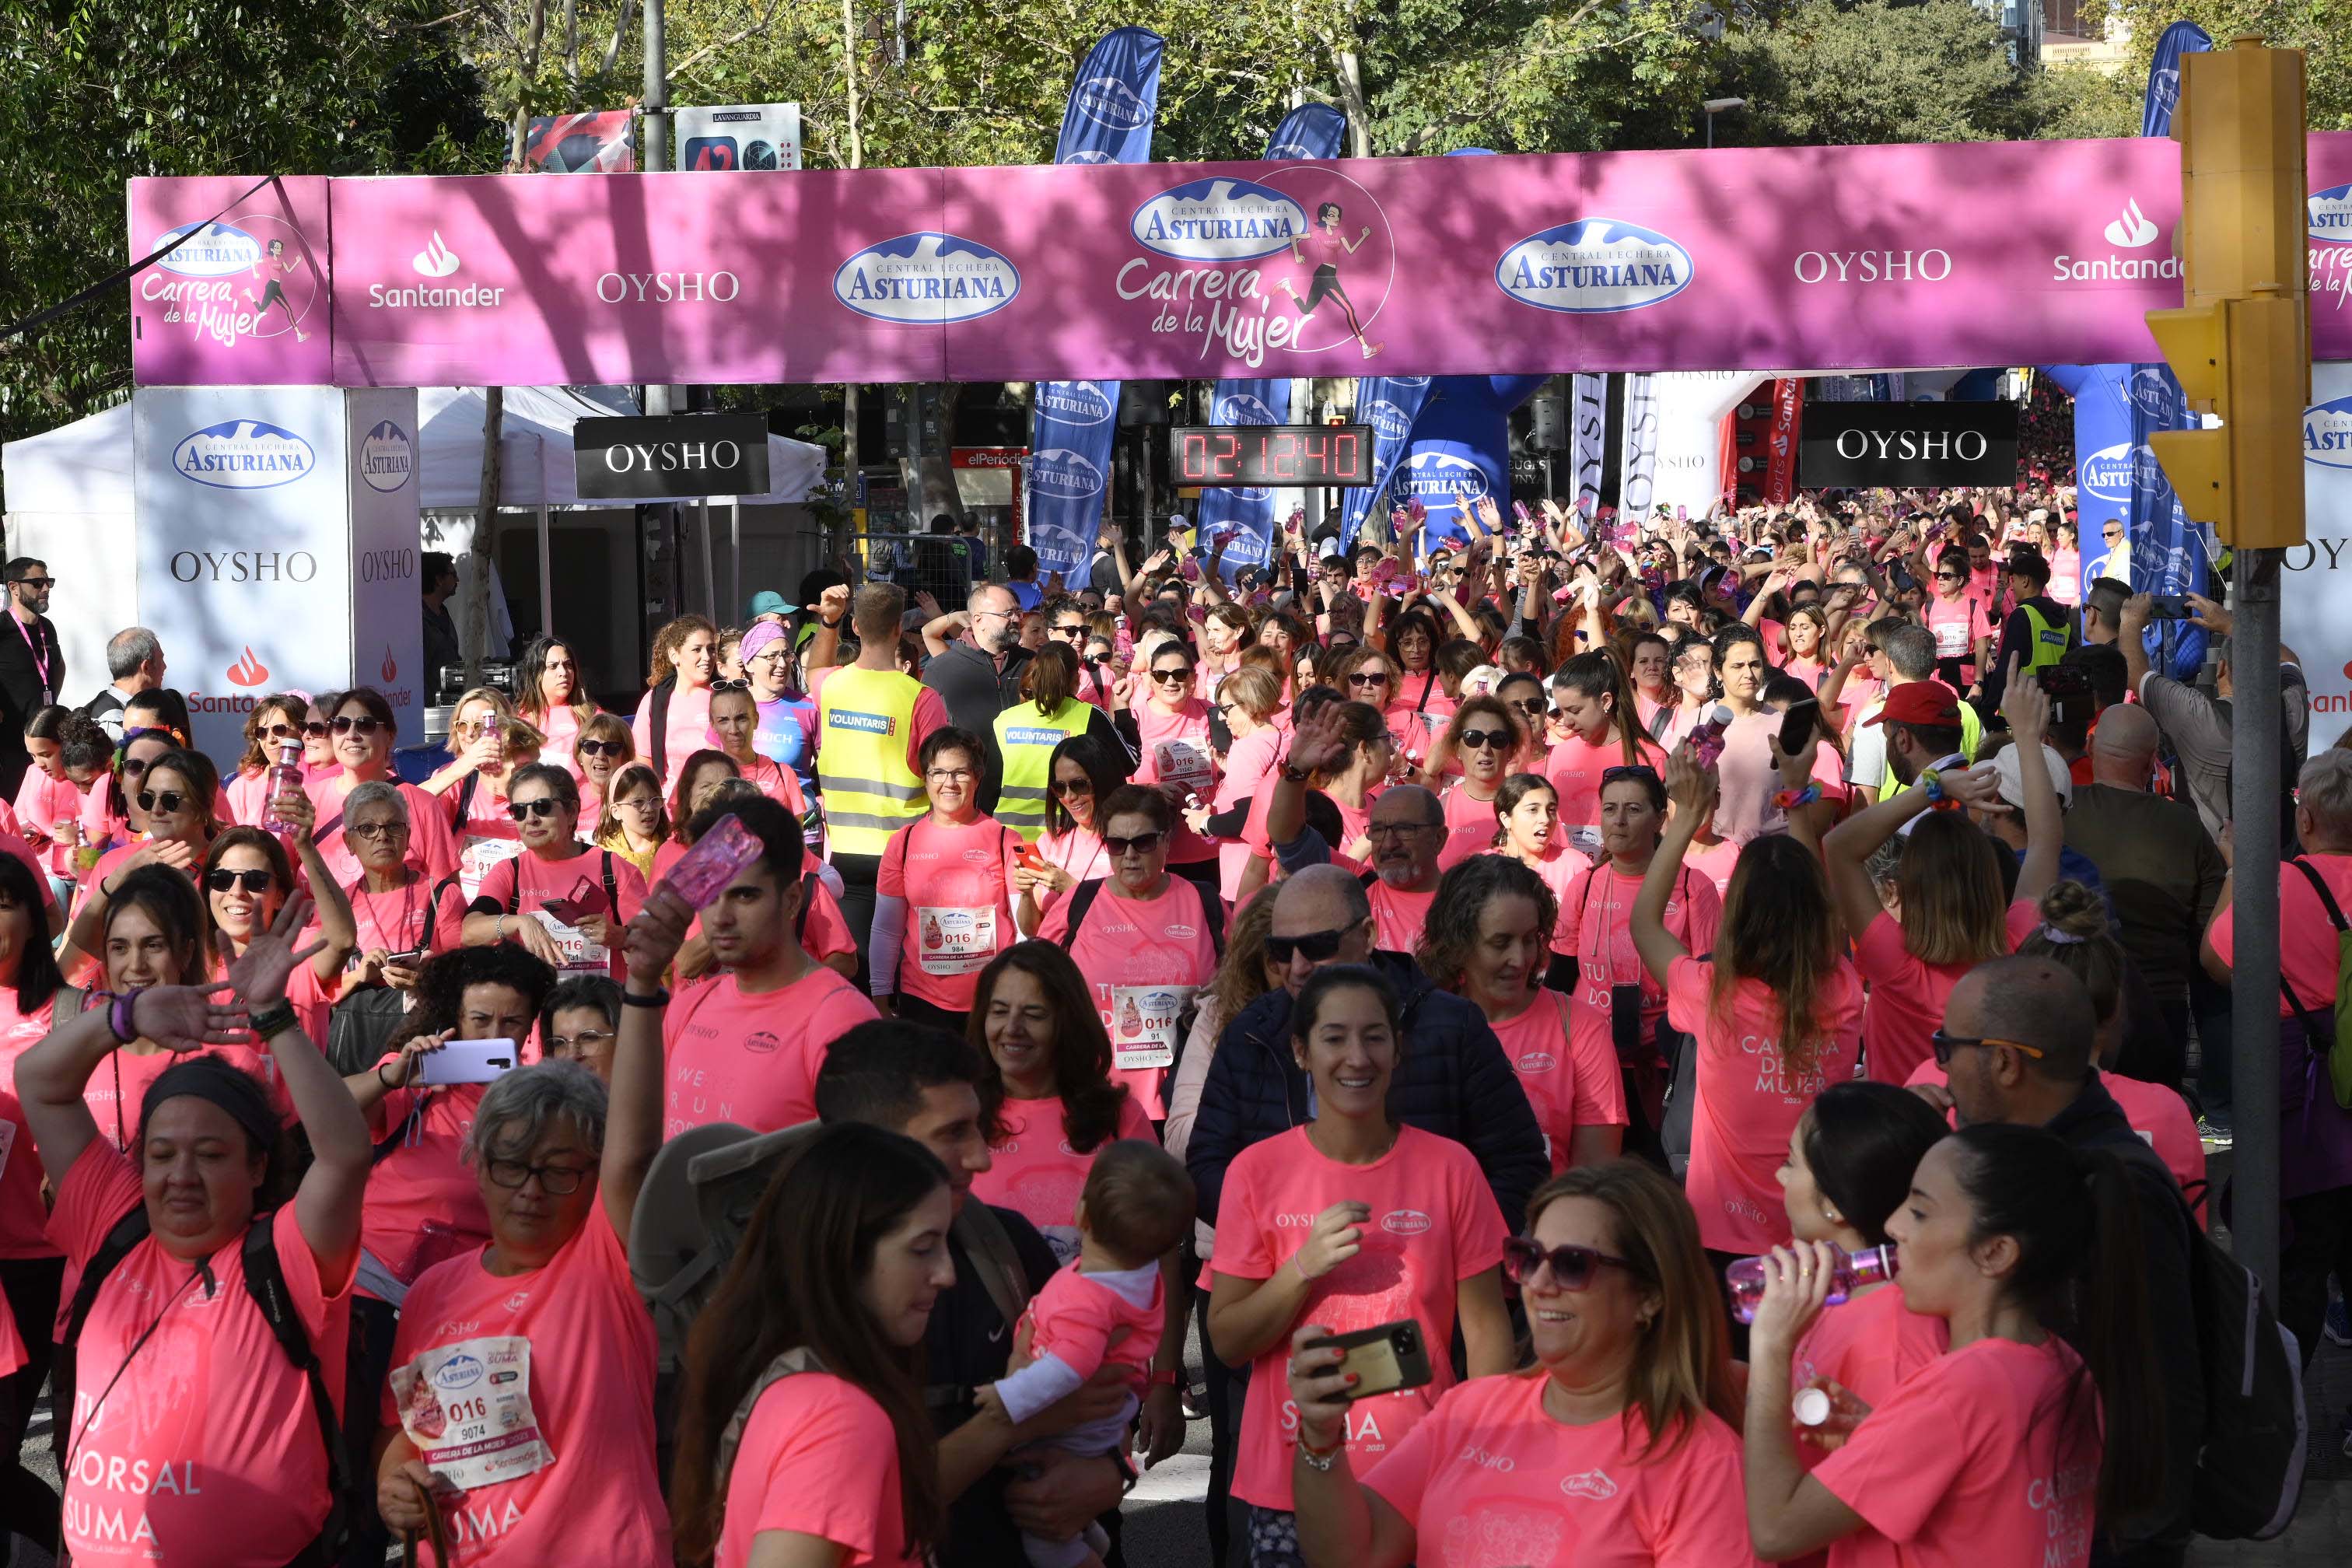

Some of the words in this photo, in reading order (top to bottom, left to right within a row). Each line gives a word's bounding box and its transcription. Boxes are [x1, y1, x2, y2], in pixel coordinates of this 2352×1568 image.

[1080, 86, 1140, 124] ASTURIANA
[1171, 206, 1226, 215] CENTRAL
[1232, 205, 1288, 215] LECHERA
[1144, 209, 1293, 240] ASTURIANA
[877, 264, 934, 273] CENTRAL
[941, 263, 999, 272] LECHERA
[1541, 251, 1602, 261] CENTRAL
[1608, 250, 1671, 259] LECHERA
[1794, 248, 1952, 283] OYSHO
[848, 267, 1006, 300] ASTURIANA
[1116, 257, 1261, 301] Carrera
[1510, 254, 1678, 289] ASTURIANA
[2326, 270, 2340, 292] la
[142, 272, 232, 302] Carrera
[369, 282, 505, 308] Santander
[597, 271, 739, 303] OYSHO
[163, 303, 180, 324] de
[185, 303, 196, 324] la
[194, 299, 268, 348] Mujer
[1151, 303, 1178, 333] de
[1184, 301, 1204, 333] la
[1199, 295, 1315, 369] Mujer
[1034, 388, 1104, 418] ASTURIANA
[605, 440, 740, 473] OYSHO
[1836, 429, 1987, 461] OYSHO
[183, 445, 305, 472] ASTURIANA
[364, 447, 410, 474] ASTURIANA
[1393, 477, 1482, 497] ASTURIANA
[170, 551, 317, 583] OYSHO
[362, 548, 414, 583] OYSHO
[187, 691, 261, 714] Santa
[829, 713, 887, 730] VOLUNTARIS
[1006, 730, 1062, 742] VOLUNTARIS
[1176, 757, 1194, 766] 016
[520, 888, 549, 897] OYSHO
[944, 933, 971, 944] 016
[1102, 923, 1139, 933] OYSHO
[1584, 962, 1605, 982] TU
[1150, 1032, 1160, 1041] 91
[1124, 1055, 1152, 1064] OYSHO
[677, 1066, 705, 1087] WE
[1384, 1217, 1429, 1231] ASTURIANA
[450, 1397, 486, 1423] 016
[461, 1424, 486, 1440] 9074
[462, 1446, 472, 1455] DE
[65, 1494, 159, 1546] SUMA
